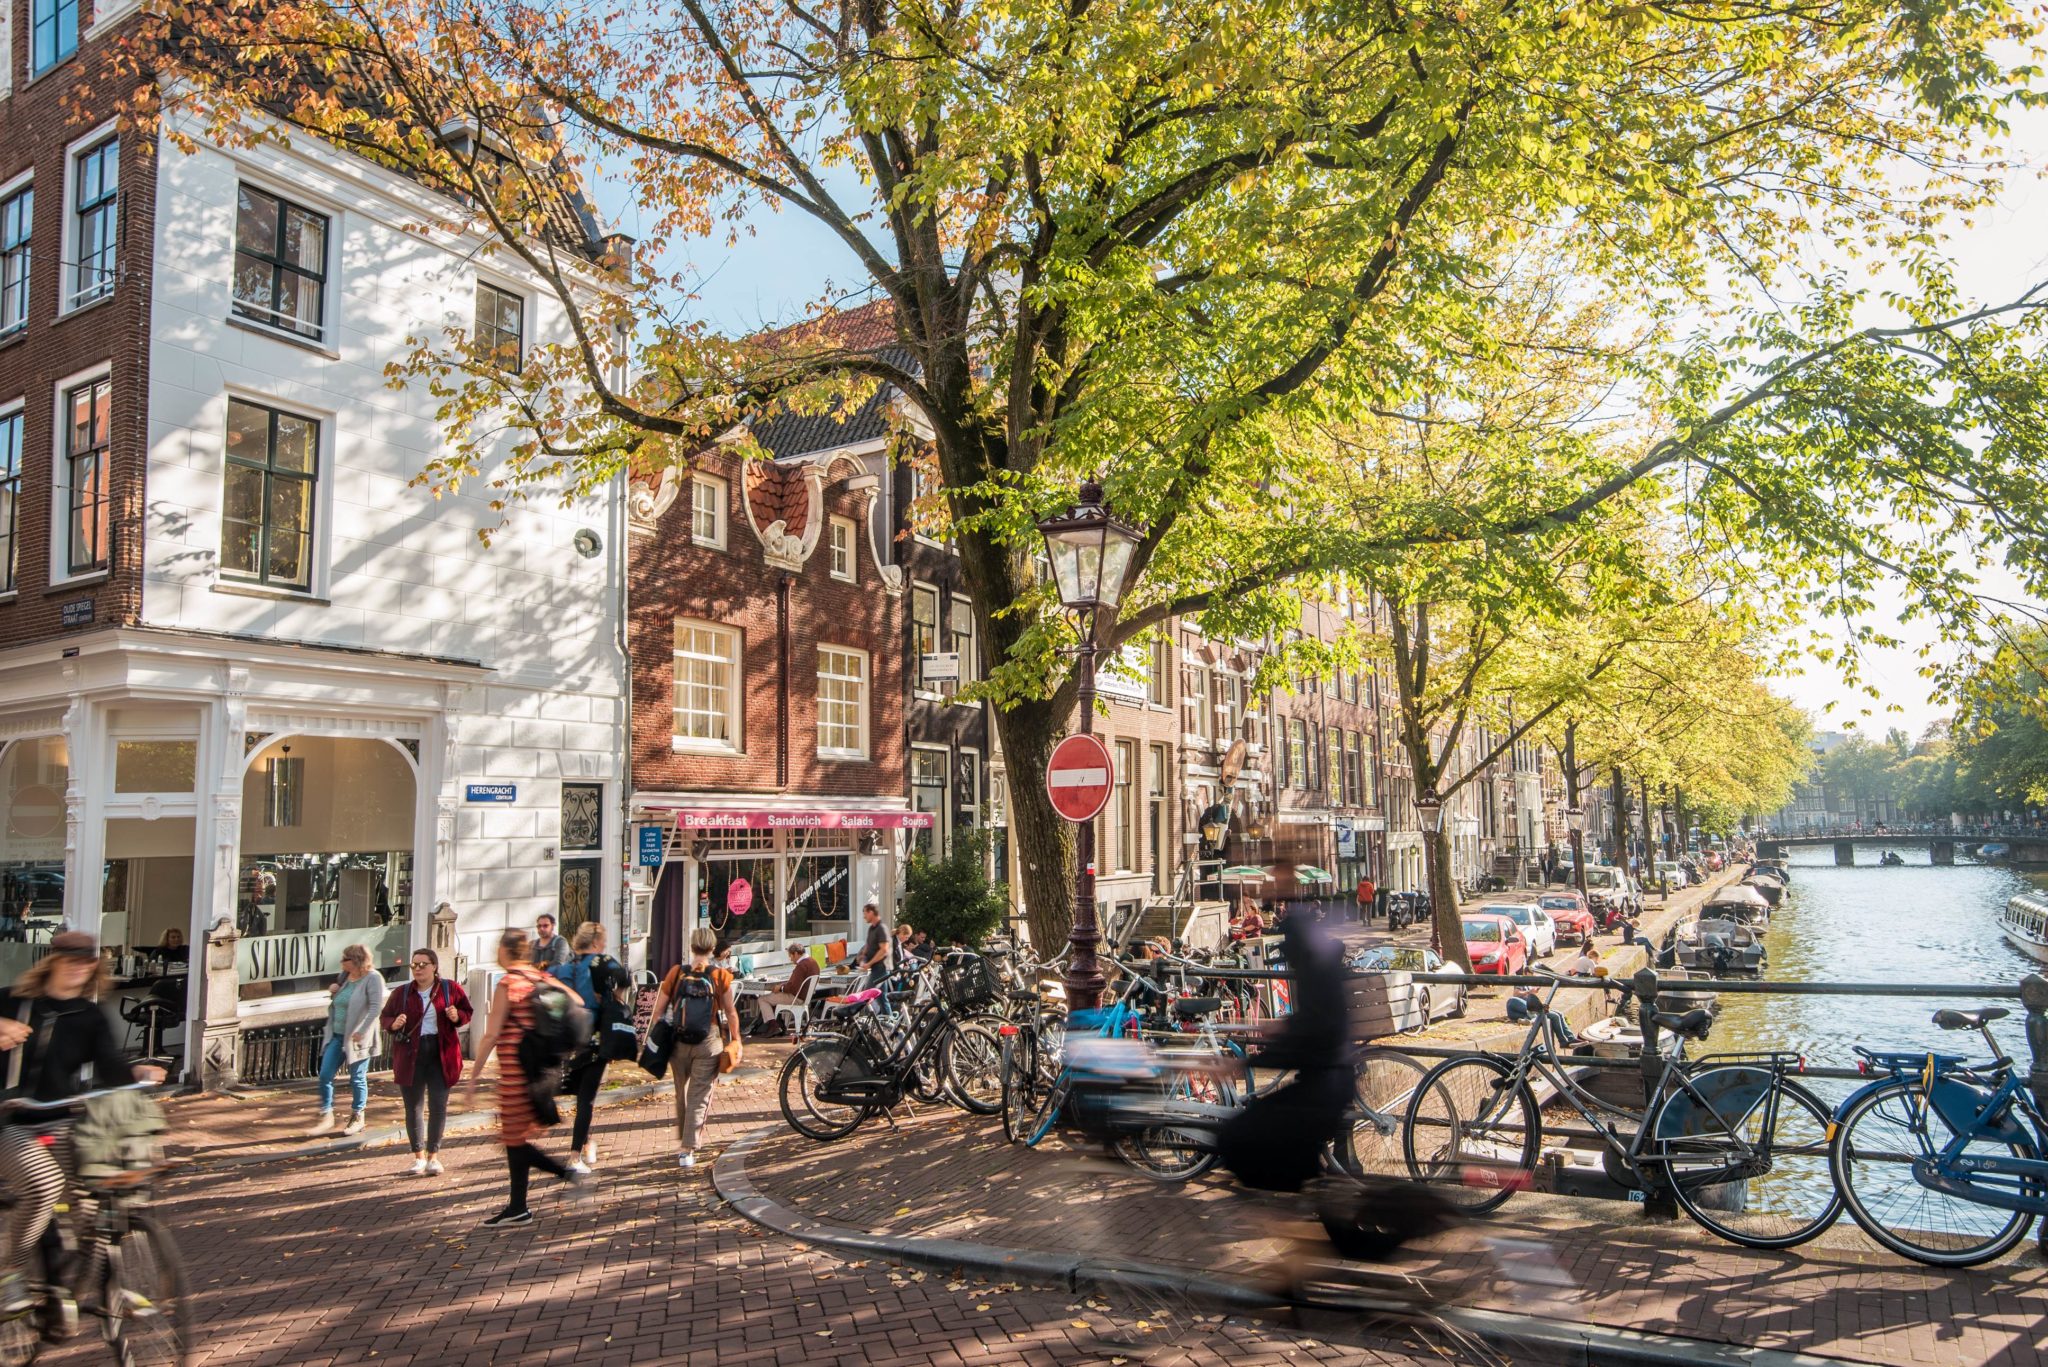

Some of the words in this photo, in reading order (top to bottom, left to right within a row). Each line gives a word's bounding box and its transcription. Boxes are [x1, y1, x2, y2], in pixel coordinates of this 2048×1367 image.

[63, 604, 76, 614] OUDE
[76, 601, 91, 611] SPIEGEL
[63, 613, 79, 625] STRAAT
[470, 786, 513, 795] HERENGRACHT
[685, 814, 748, 827] Breakfast
[767, 815, 822, 826] Sandwich
[841, 816, 874, 826] Salads
[902, 816, 929, 827] Soups
[641, 854, 649, 863] To
[649, 854, 660, 863] Go
[786, 897, 800, 914] BEST
[799, 885, 814, 903] SOUP
[820, 866, 837, 885] TOWN
[249, 934, 327, 981] SIMONE
